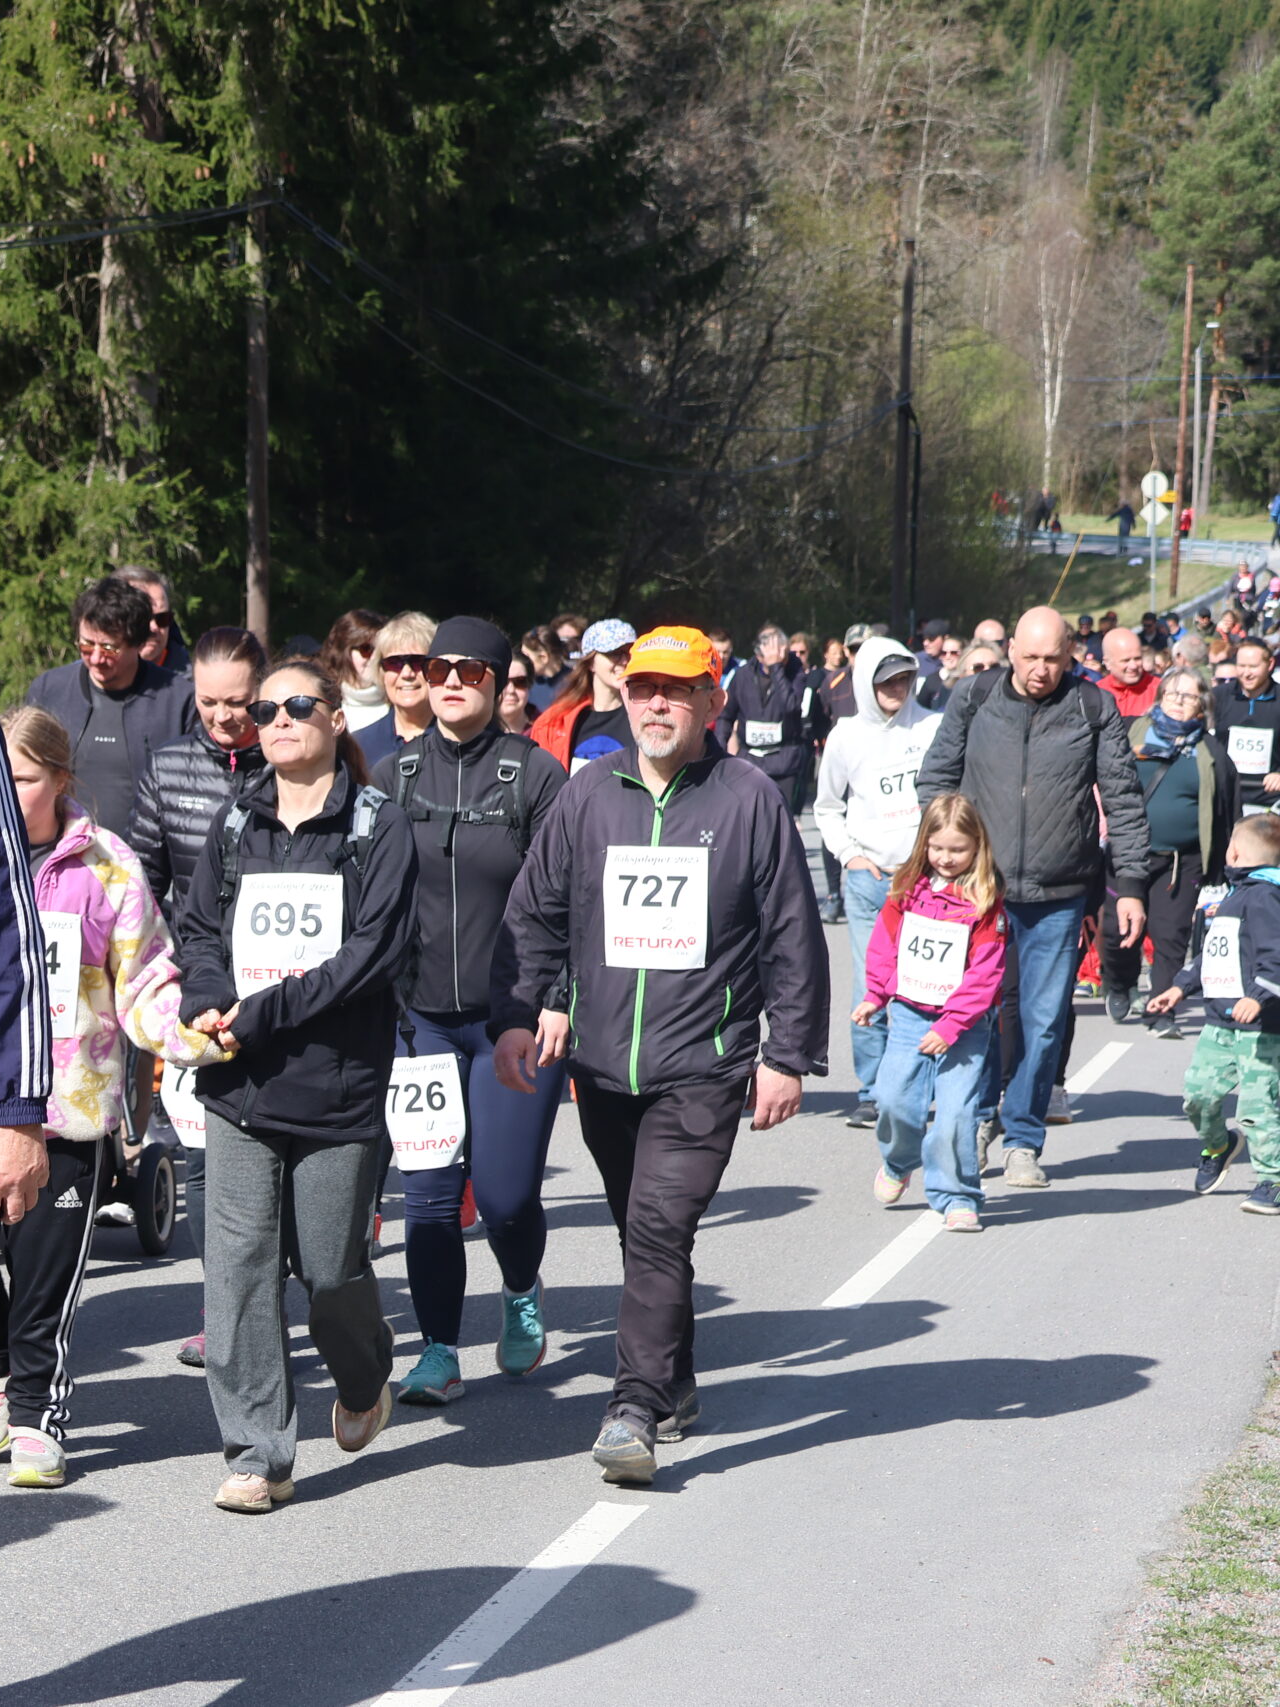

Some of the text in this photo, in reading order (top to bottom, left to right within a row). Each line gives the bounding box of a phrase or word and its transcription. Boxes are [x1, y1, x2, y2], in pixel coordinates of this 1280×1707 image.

[1236, 738, 1264, 752] 655
[879, 769, 919, 795] 677
[618, 874, 689, 908] 727
[250, 902, 323, 937] 695
[613, 936, 688, 949] RETURA
[907, 936, 954, 963] 457
[388, 1081, 446, 1113] 726
[54, 1199, 83, 1208] adidas
